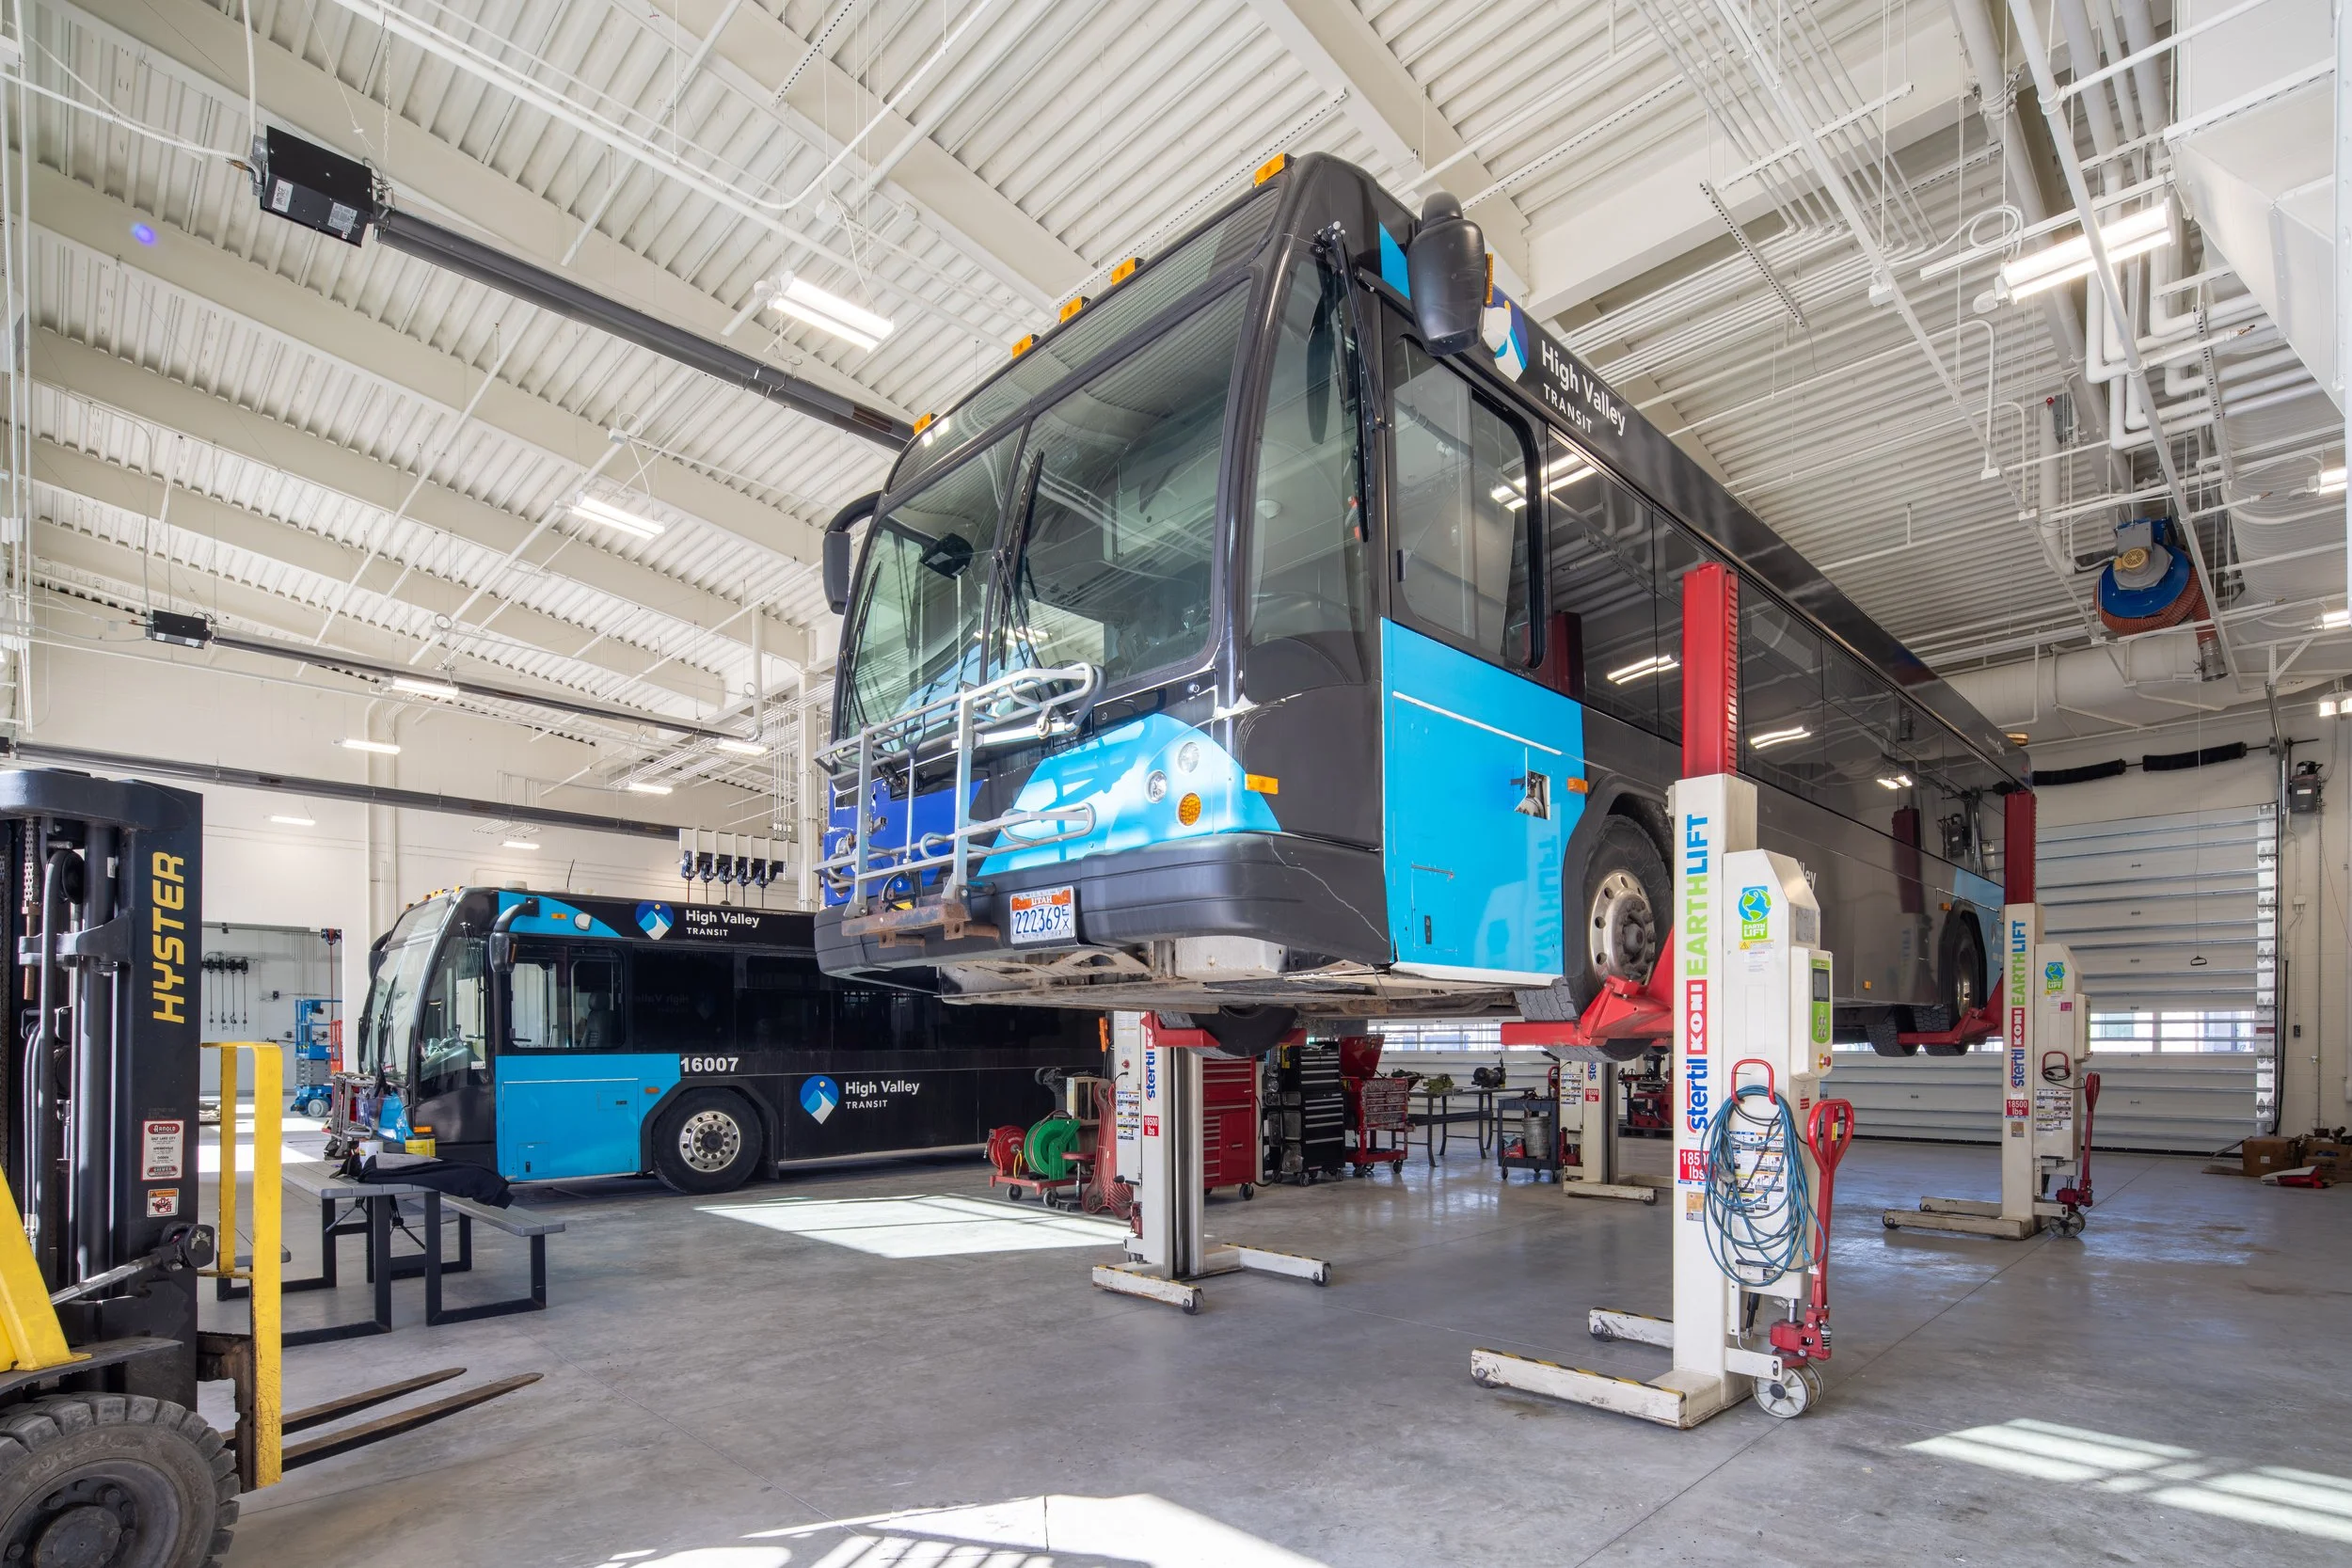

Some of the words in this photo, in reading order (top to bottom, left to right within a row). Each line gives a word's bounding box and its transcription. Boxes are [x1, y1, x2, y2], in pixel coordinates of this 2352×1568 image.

[1542, 340, 1579, 393] High
[1582, 374, 1626, 436] Valley
[1543, 383, 1592, 433] TRANSIT
[1031, 895, 1053, 906] UTAH
[1686, 814, 1708, 975] EARTHLIFT
[686, 910, 717, 926] High
[721, 911, 760, 928] Valley
[686, 927, 728, 937] TRANSIT
[1015, 906, 1061, 934] 222369
[1743, 928, 1766, 938] LIFT
[152, 851, 184, 1024] HYSTER
[2011, 920, 2026, 1006] EARTHLIFT
[1690, 984, 1704, 1051] KONI
[2013, 1009, 2023, 1046] KONI
[680, 1057, 739, 1072] 16007
[1146, 1052, 1155, 1100] stertil
[2011, 1049, 2025, 1088] stertil
[845, 1082, 877, 1097] High
[881, 1081, 920, 1095] Valley
[1686, 1058, 1708, 1133] stertil
[846, 1100, 888, 1110] TRANSIT
[1144, 1117, 1158, 1126] 18500
[1147, 1126, 1155, 1135] lbs
[1689, 1164, 1706, 1180] lbs
